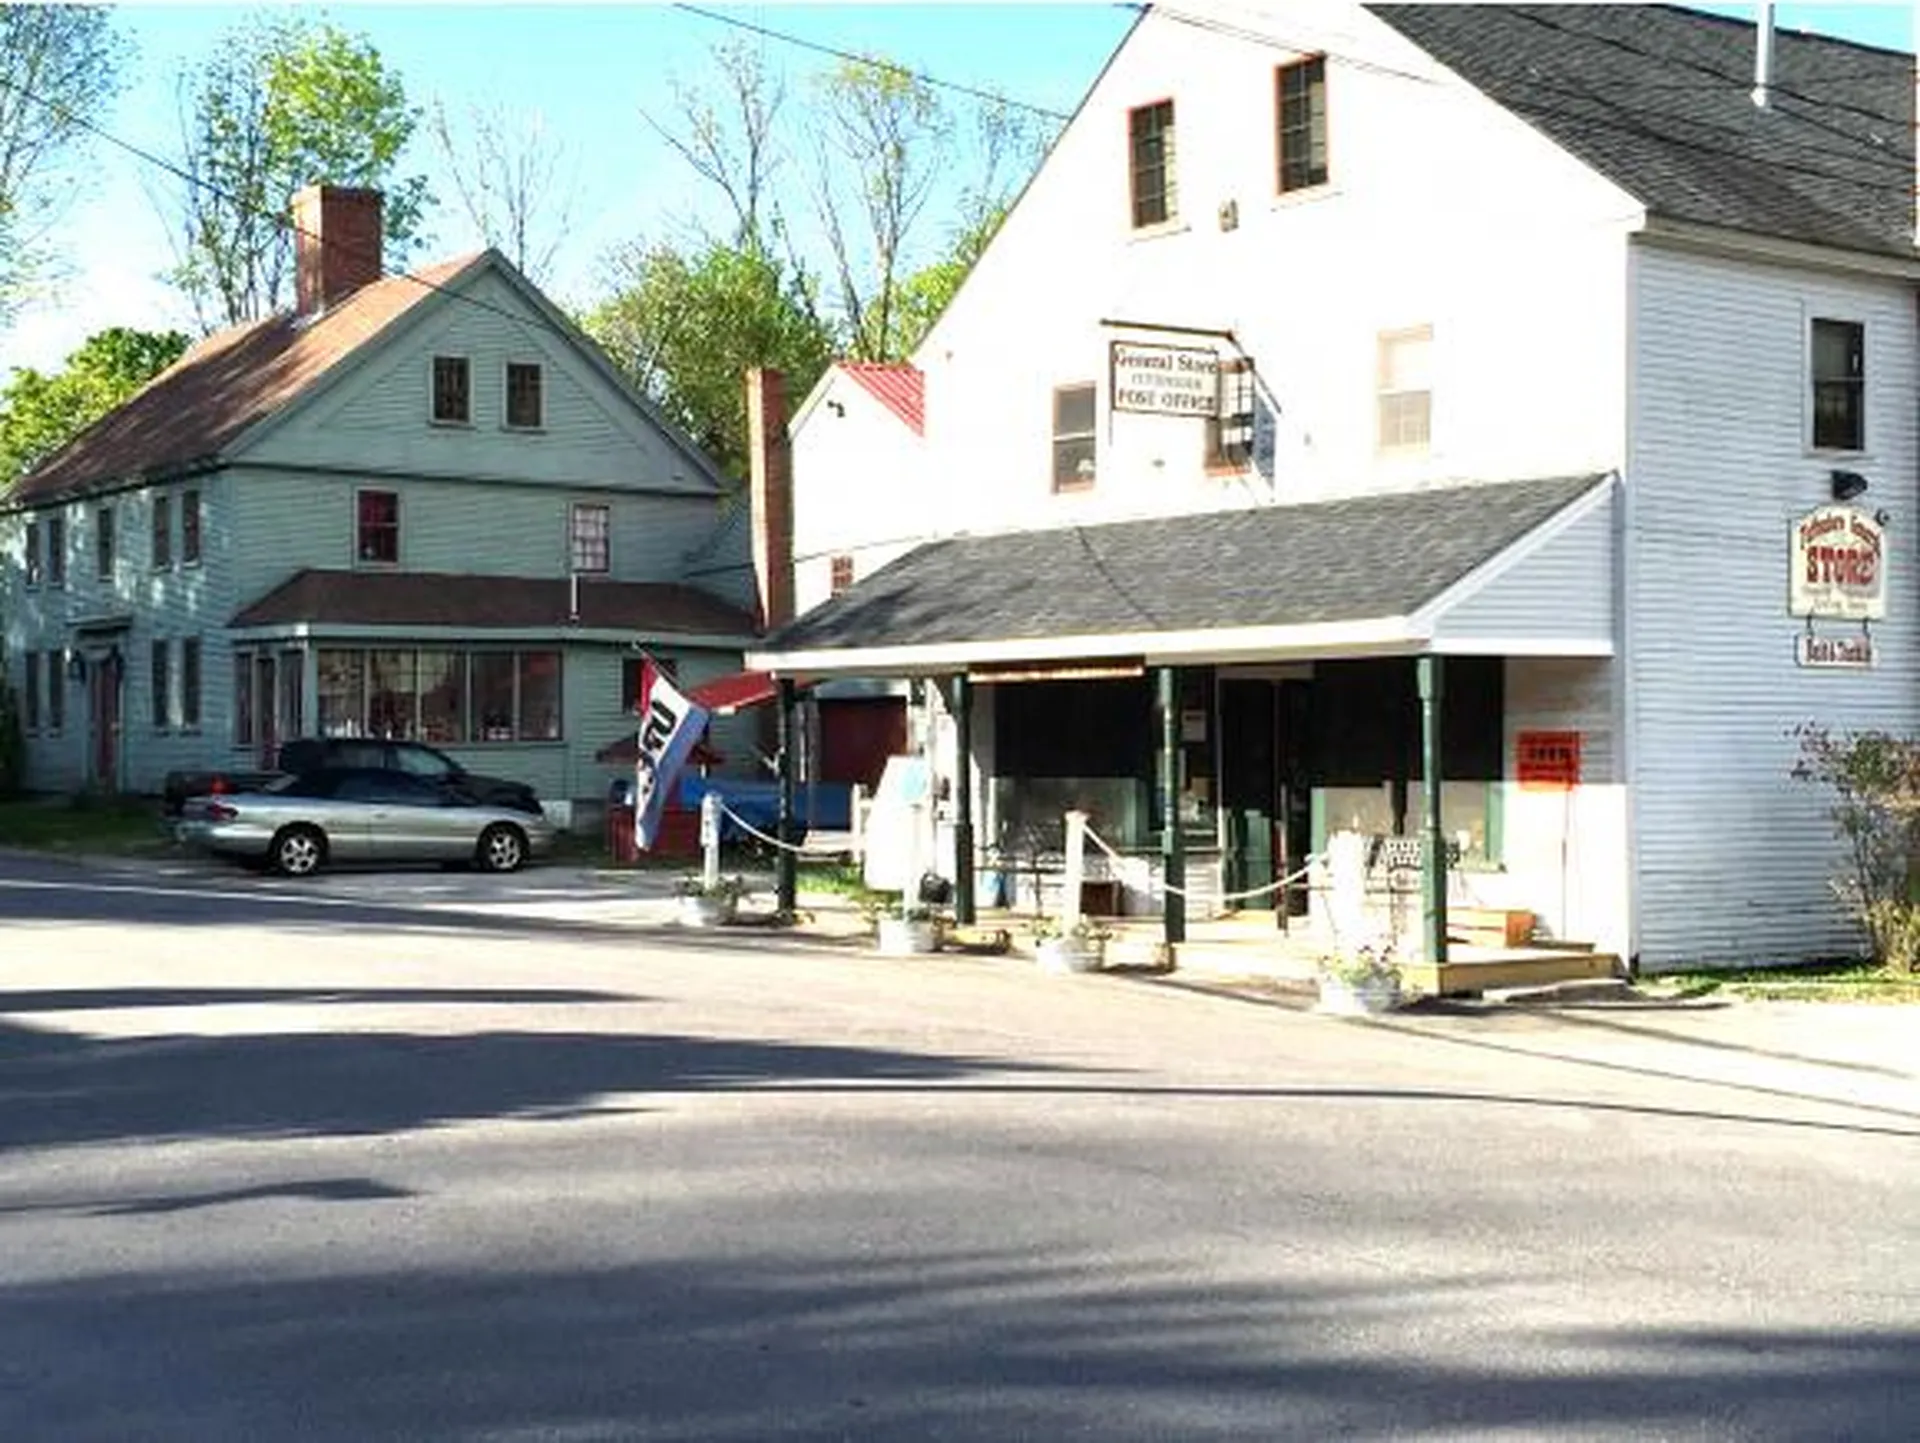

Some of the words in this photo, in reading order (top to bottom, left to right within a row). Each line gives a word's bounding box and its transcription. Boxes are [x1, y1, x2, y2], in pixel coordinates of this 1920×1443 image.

[1177, 354, 1217, 374] Store
[1118, 388, 1154, 406] POST
[1161, 393, 1215, 411] OFFICE
[1806, 545, 1875, 585] STORE
